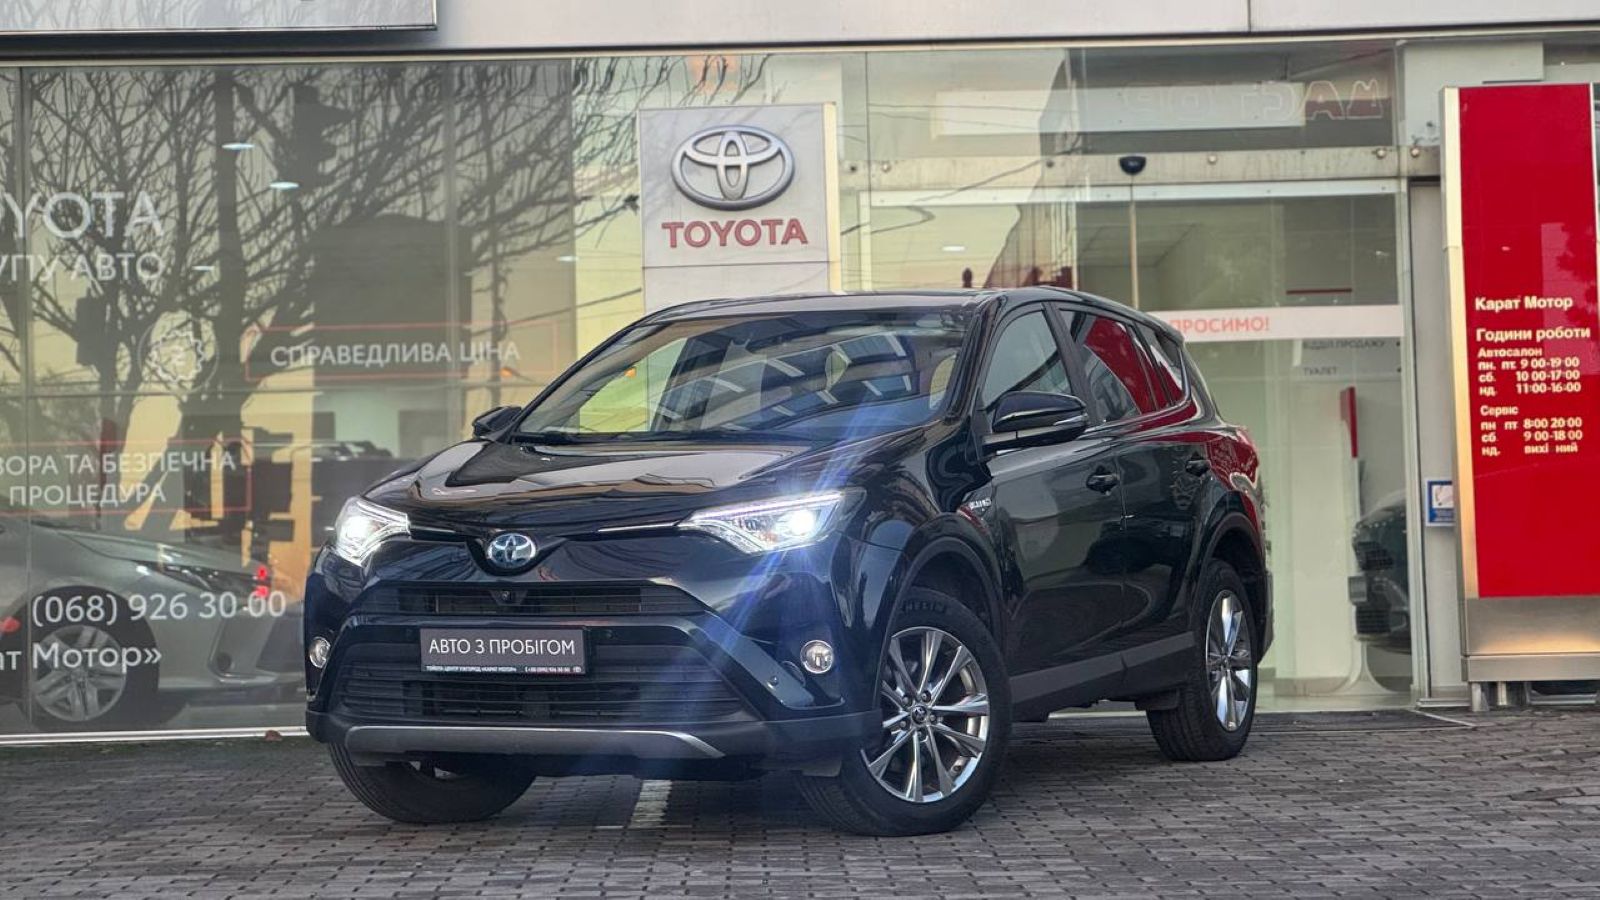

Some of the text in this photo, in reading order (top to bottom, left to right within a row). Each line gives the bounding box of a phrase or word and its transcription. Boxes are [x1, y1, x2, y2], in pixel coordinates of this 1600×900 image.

[0, 191, 164, 239] YOTA
[661, 218, 808, 248] TOYOTA
[70, 253, 164, 282] АВТО
[1475, 295, 1573, 313] Карат Мотор
[1476, 326, 1591, 342] Години роботи
[270, 341, 521, 368] СПРАВЕДЛИВА ЦІНА
[1477, 347, 1543, 358] Автосалон
[1480, 405, 1519, 418] Сервіс
[64, 454, 95, 474] ТА
[103, 451, 236, 474] БЕЗПЕЧНА
[10, 482, 167, 508] ПРОЦЕДУРА
[32, 591, 287, 627] (068) 926 30 00
[33, 643, 162, 673] Мотор»
[429, 638, 471, 655] АВТО
[489, 639, 575, 655] ПРОБІГОМ
